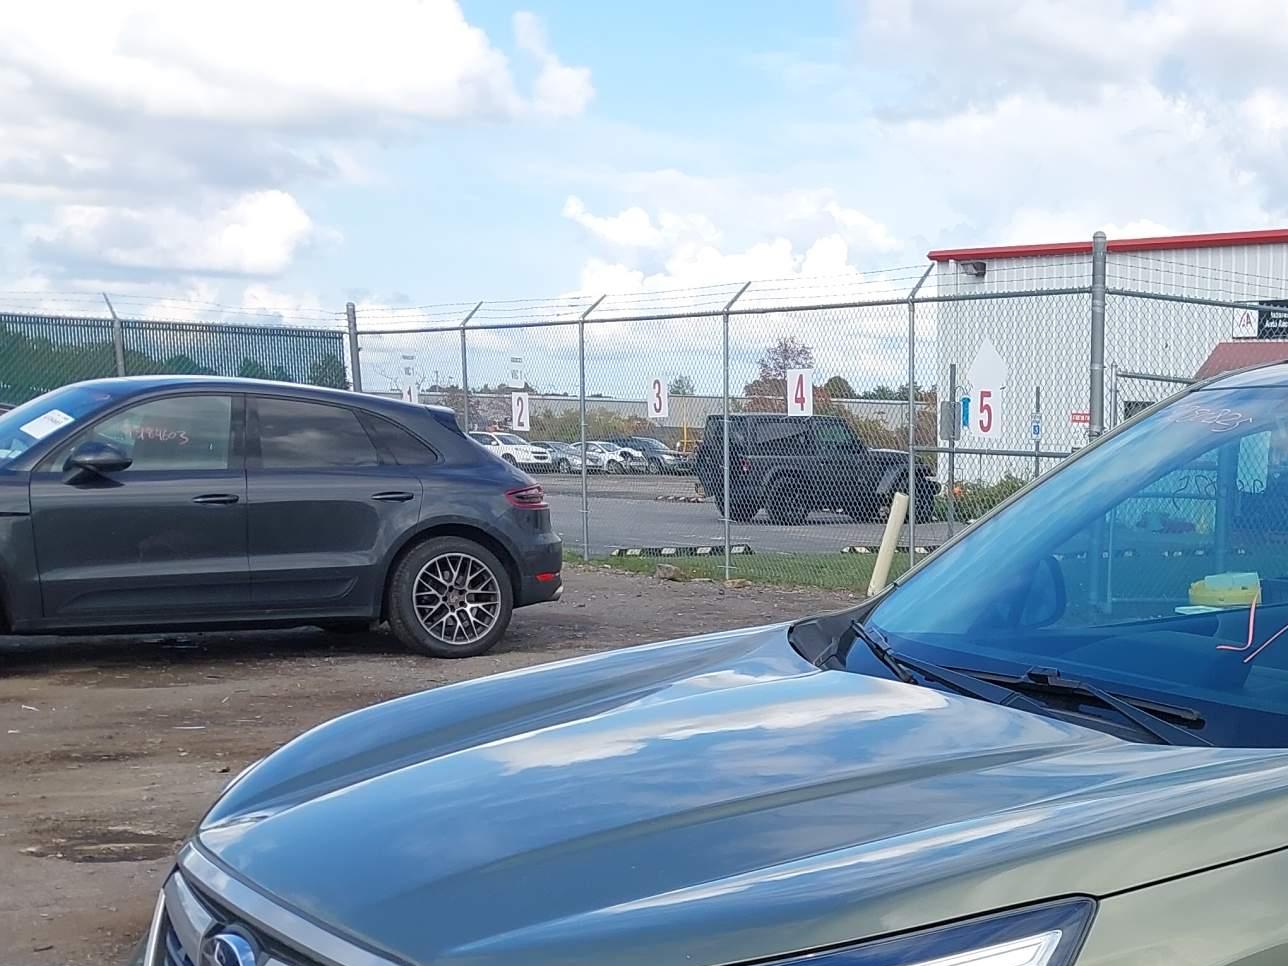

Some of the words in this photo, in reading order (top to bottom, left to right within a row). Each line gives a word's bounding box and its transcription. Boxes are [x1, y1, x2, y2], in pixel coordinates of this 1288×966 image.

[652, 379, 663, 413] 3
[794, 373, 806, 412] 4
[516, 396, 525, 427] 2
[979, 390, 993, 433] 5
